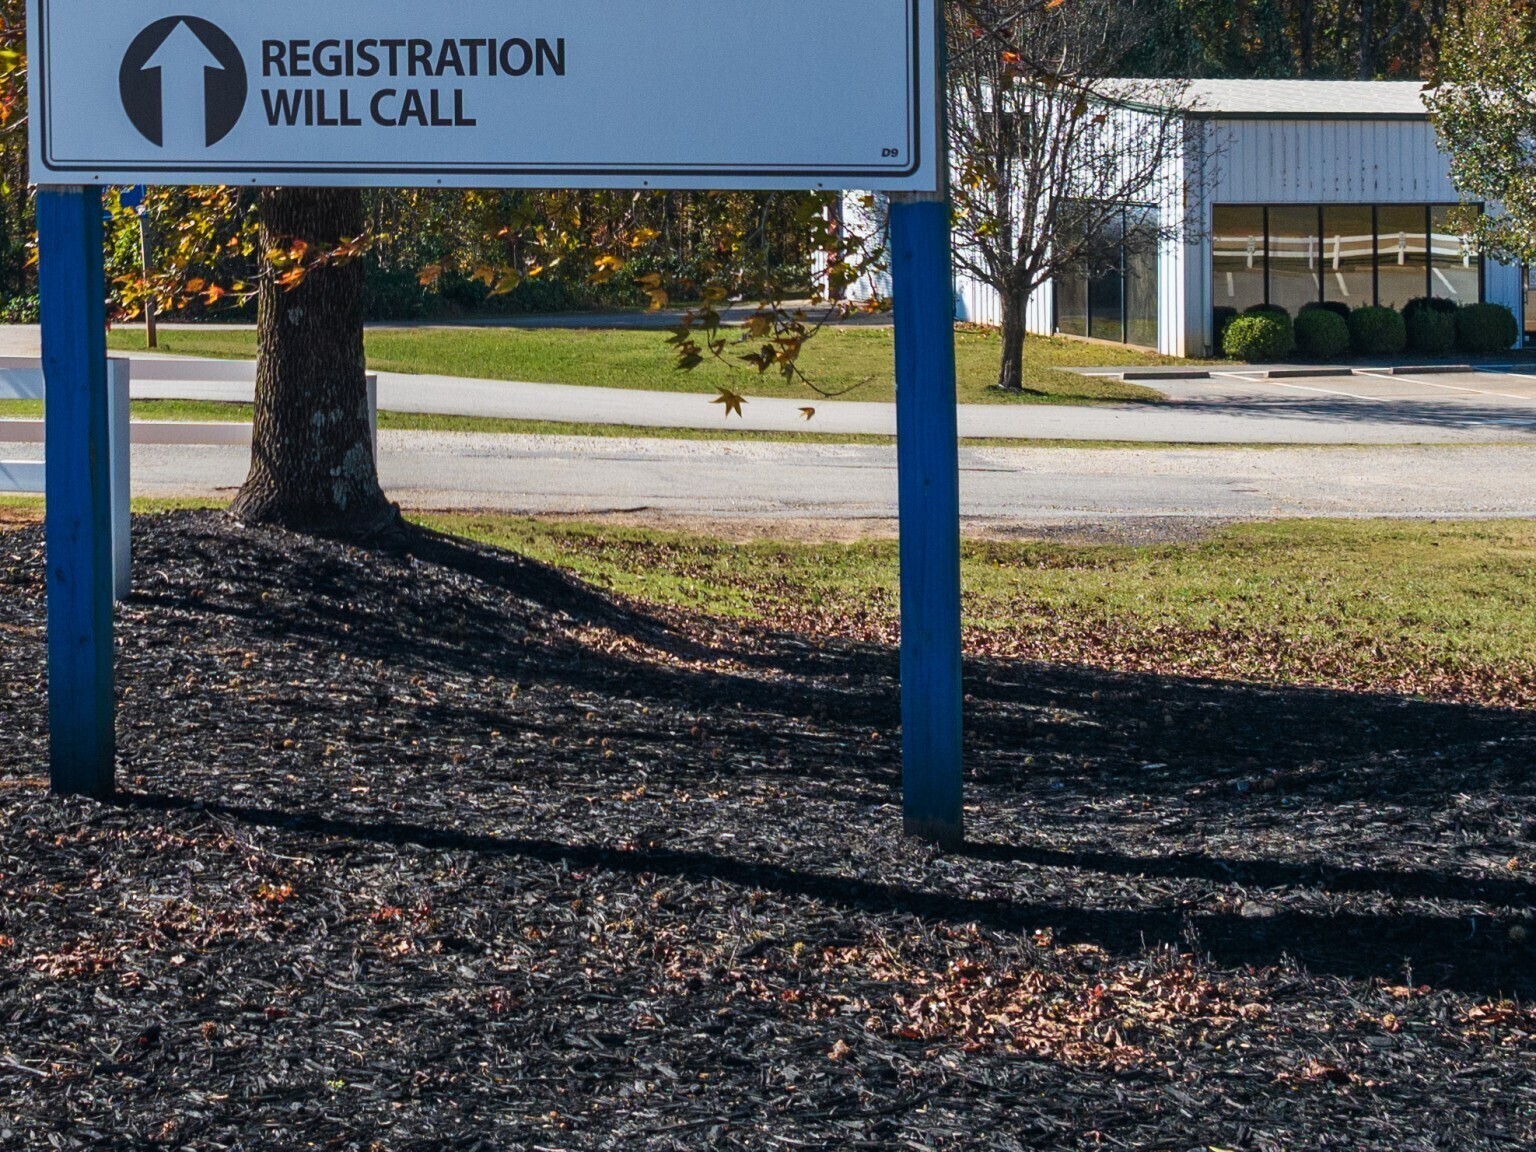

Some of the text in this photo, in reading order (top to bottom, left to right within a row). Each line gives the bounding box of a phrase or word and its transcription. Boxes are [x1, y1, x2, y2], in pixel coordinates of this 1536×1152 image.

[262, 38, 565, 77] REGISTRATION
[261, 89, 476, 127] WILL CALL
[881, 148, 899, 158] D9
